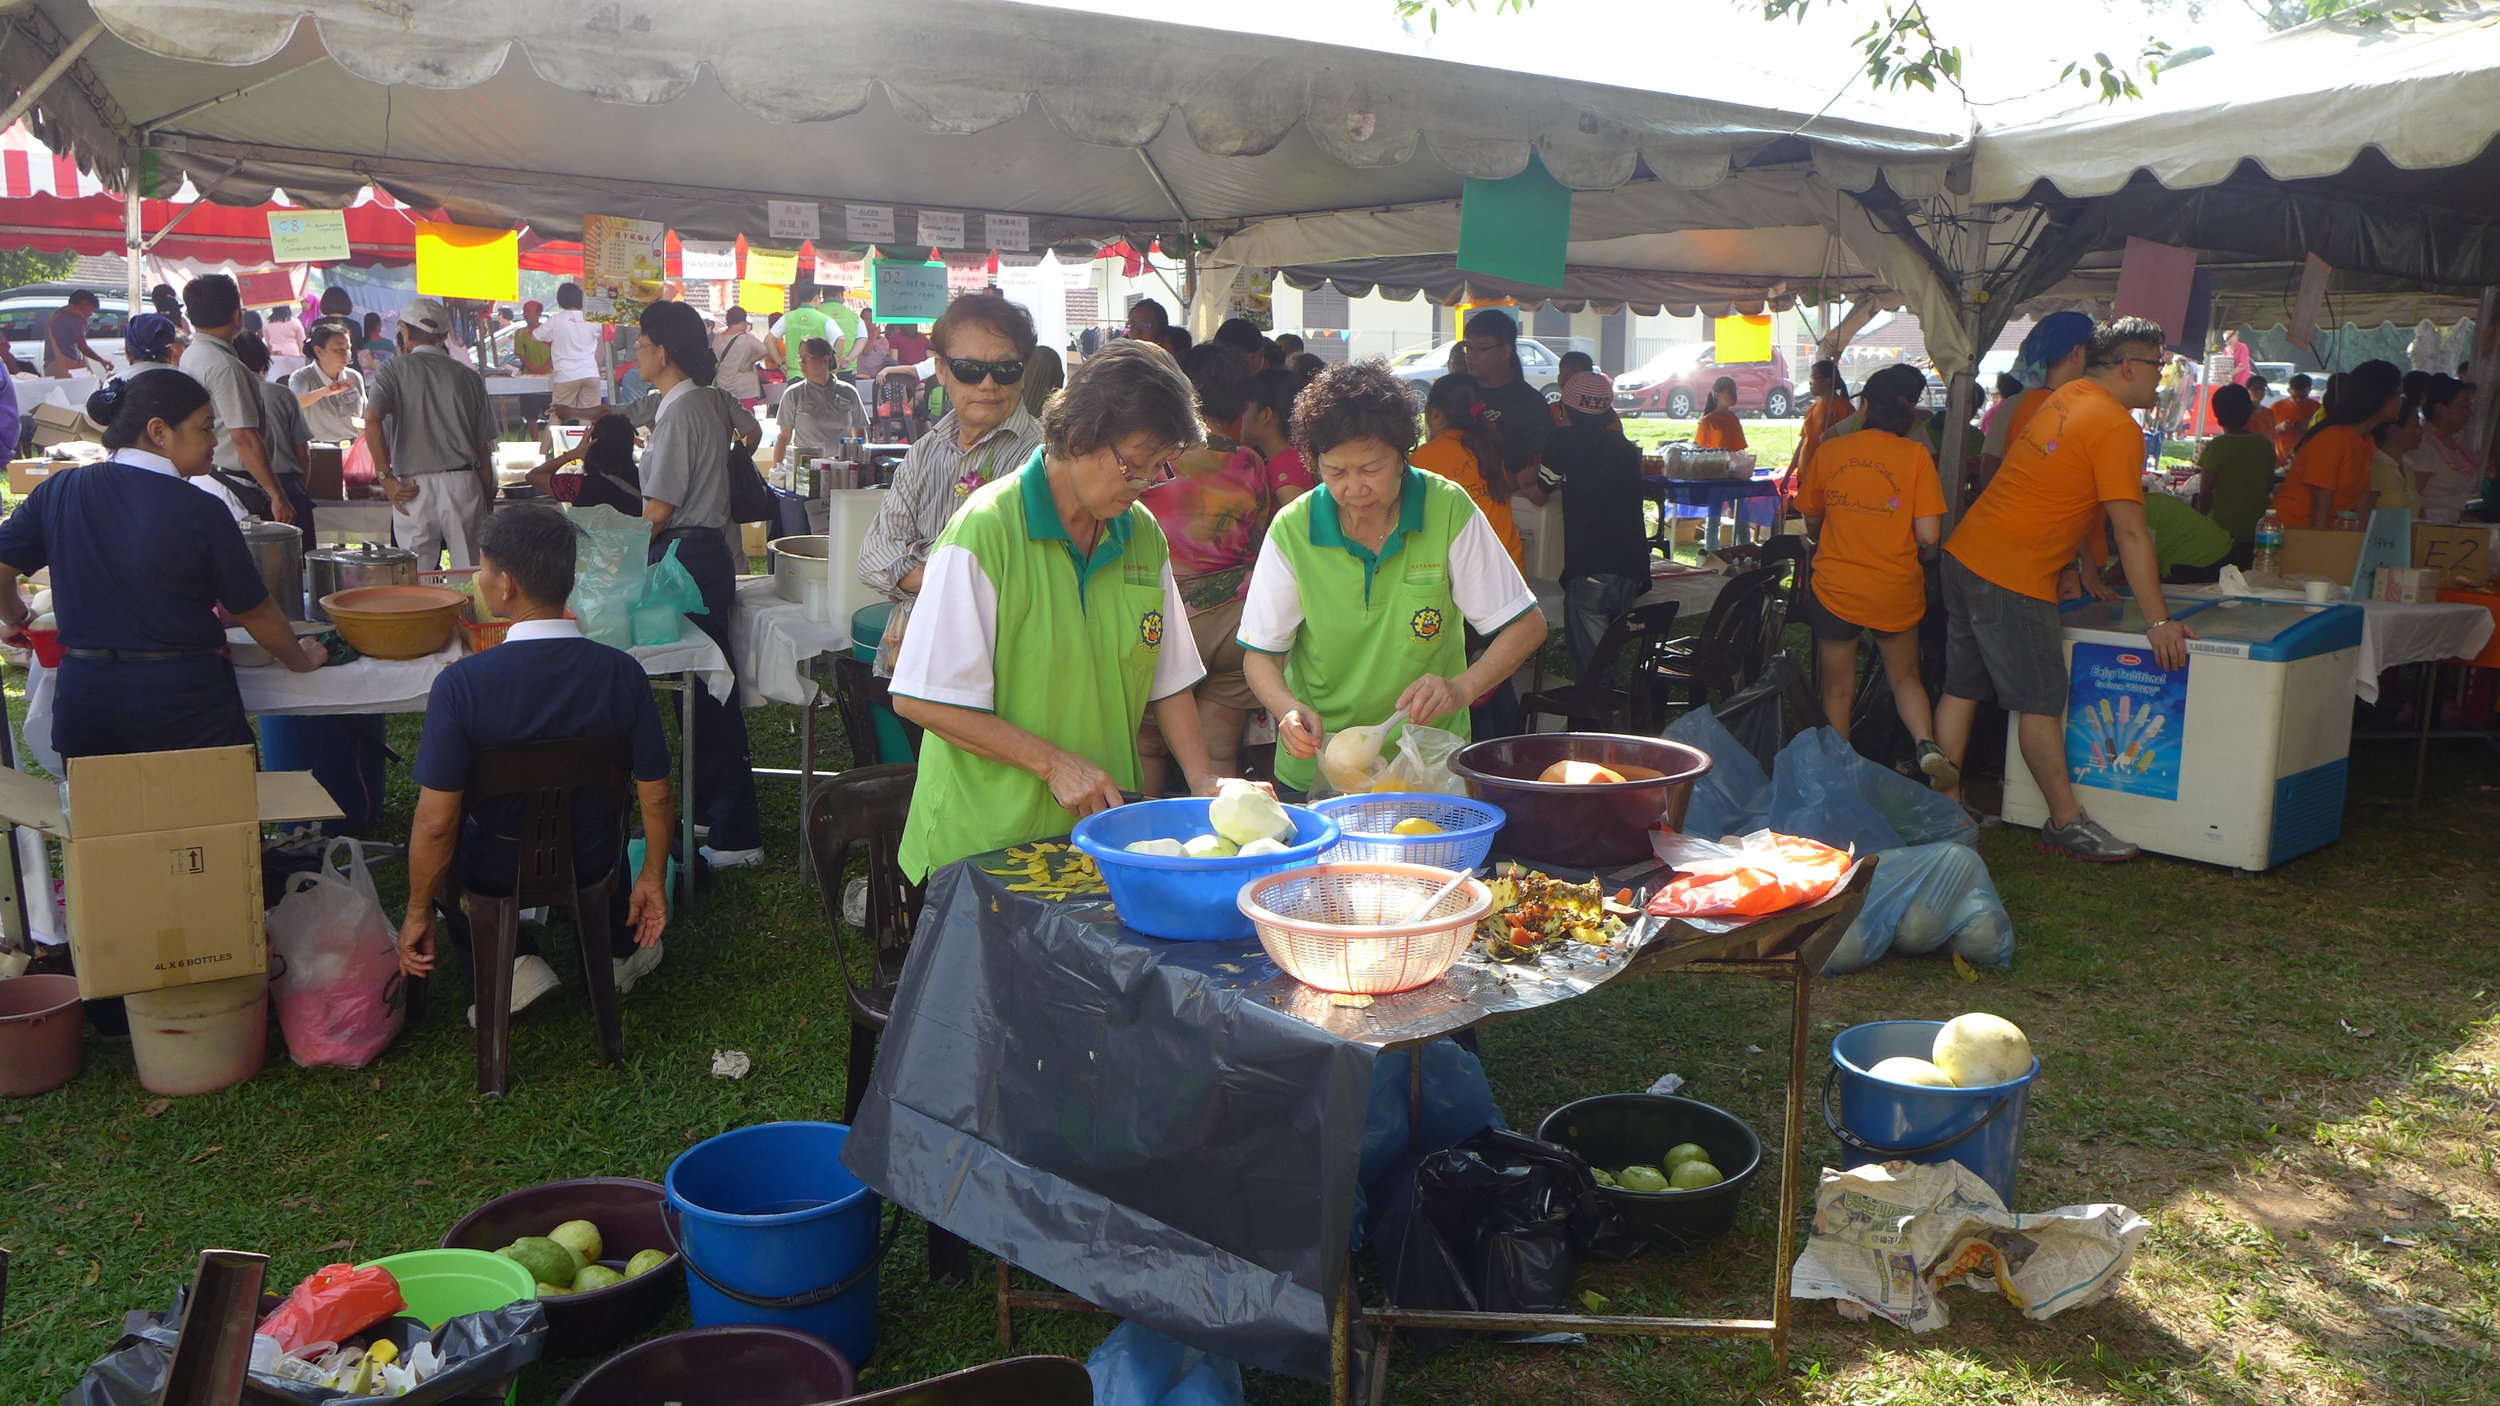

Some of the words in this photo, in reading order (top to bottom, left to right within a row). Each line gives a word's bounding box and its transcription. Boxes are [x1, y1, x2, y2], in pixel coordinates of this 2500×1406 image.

[2424, 539, 2479, 572] E2
[2090, 665, 2116, 680] Enjoy
[2118, 668, 2167, 685] Traditional
[154, 963, 167, 971] 4L
[169, 961, 176, 969] X
[178, 960, 185, 968] 6
[186, 953, 233, 966] BOTTLES
